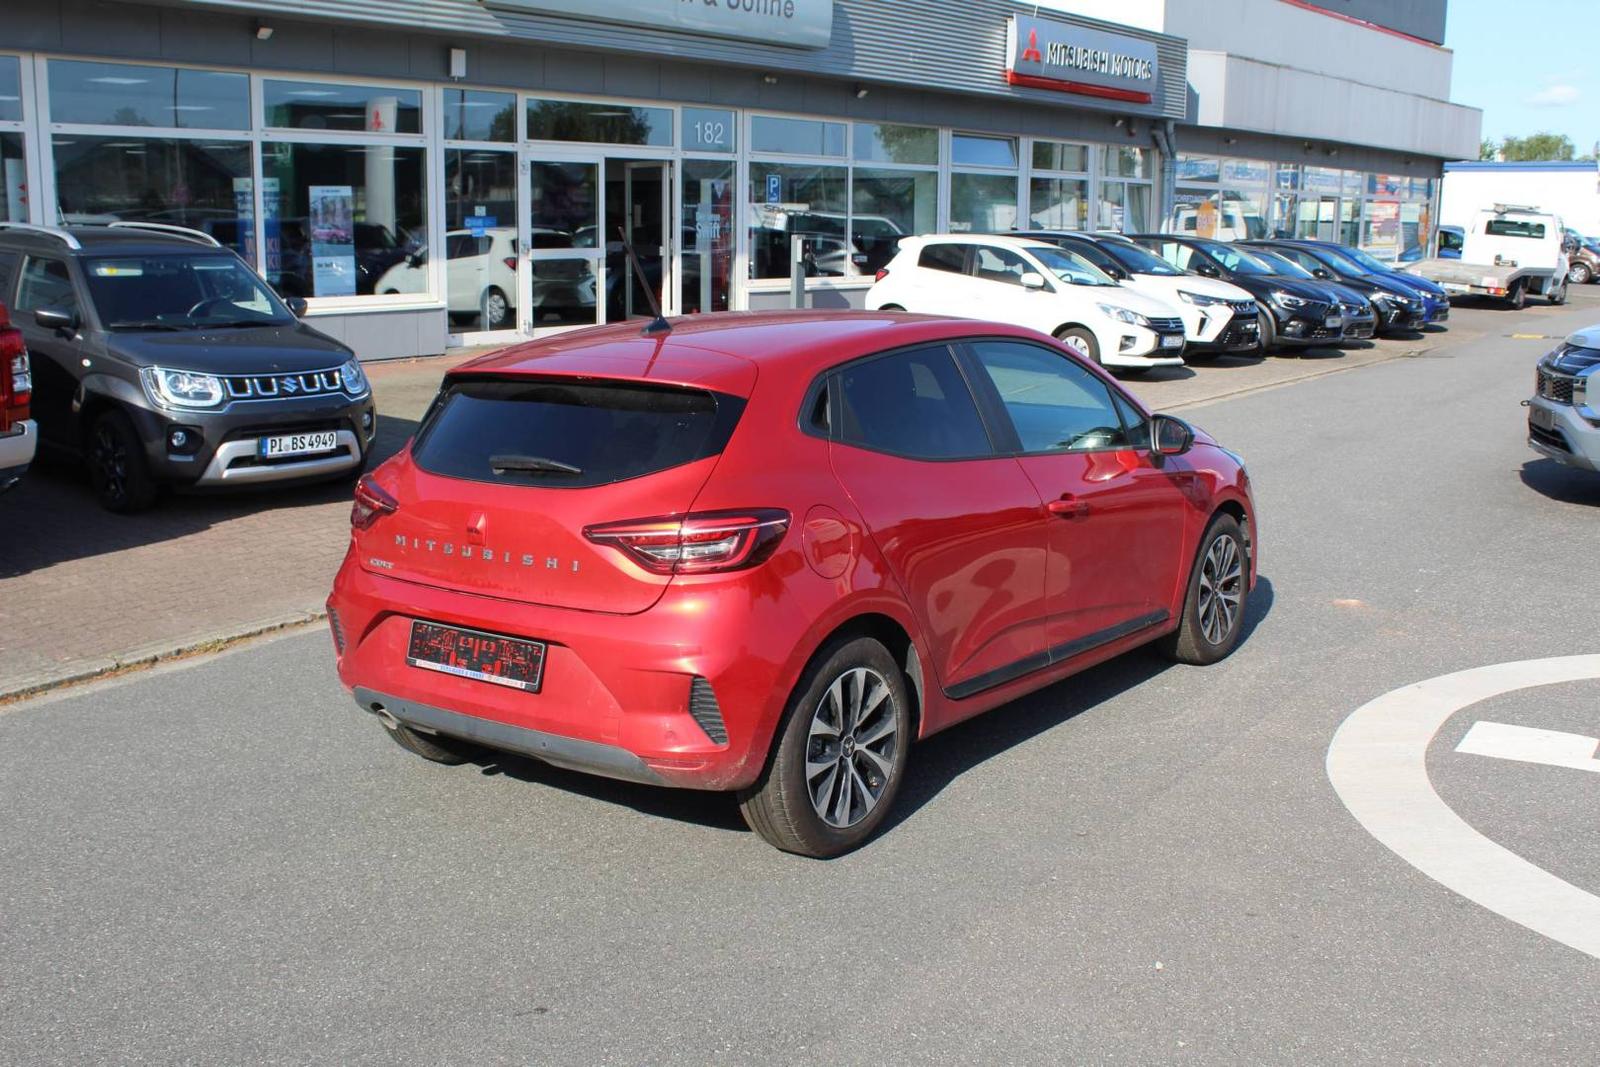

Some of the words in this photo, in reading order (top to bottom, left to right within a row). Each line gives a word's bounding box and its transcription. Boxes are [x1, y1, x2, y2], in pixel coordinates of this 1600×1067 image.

[1046, 42, 1109, 74] MITSUBISHI
[1111, 53, 1152, 80] MOTORS
[694, 121, 724, 145] 182
[769, 177, 778, 193] P
[269, 436, 284, 453] PI
[291, 434, 306, 451] BS
[308, 432, 335, 449] 4949
[395, 534, 581, 573] MITSUBISHI
